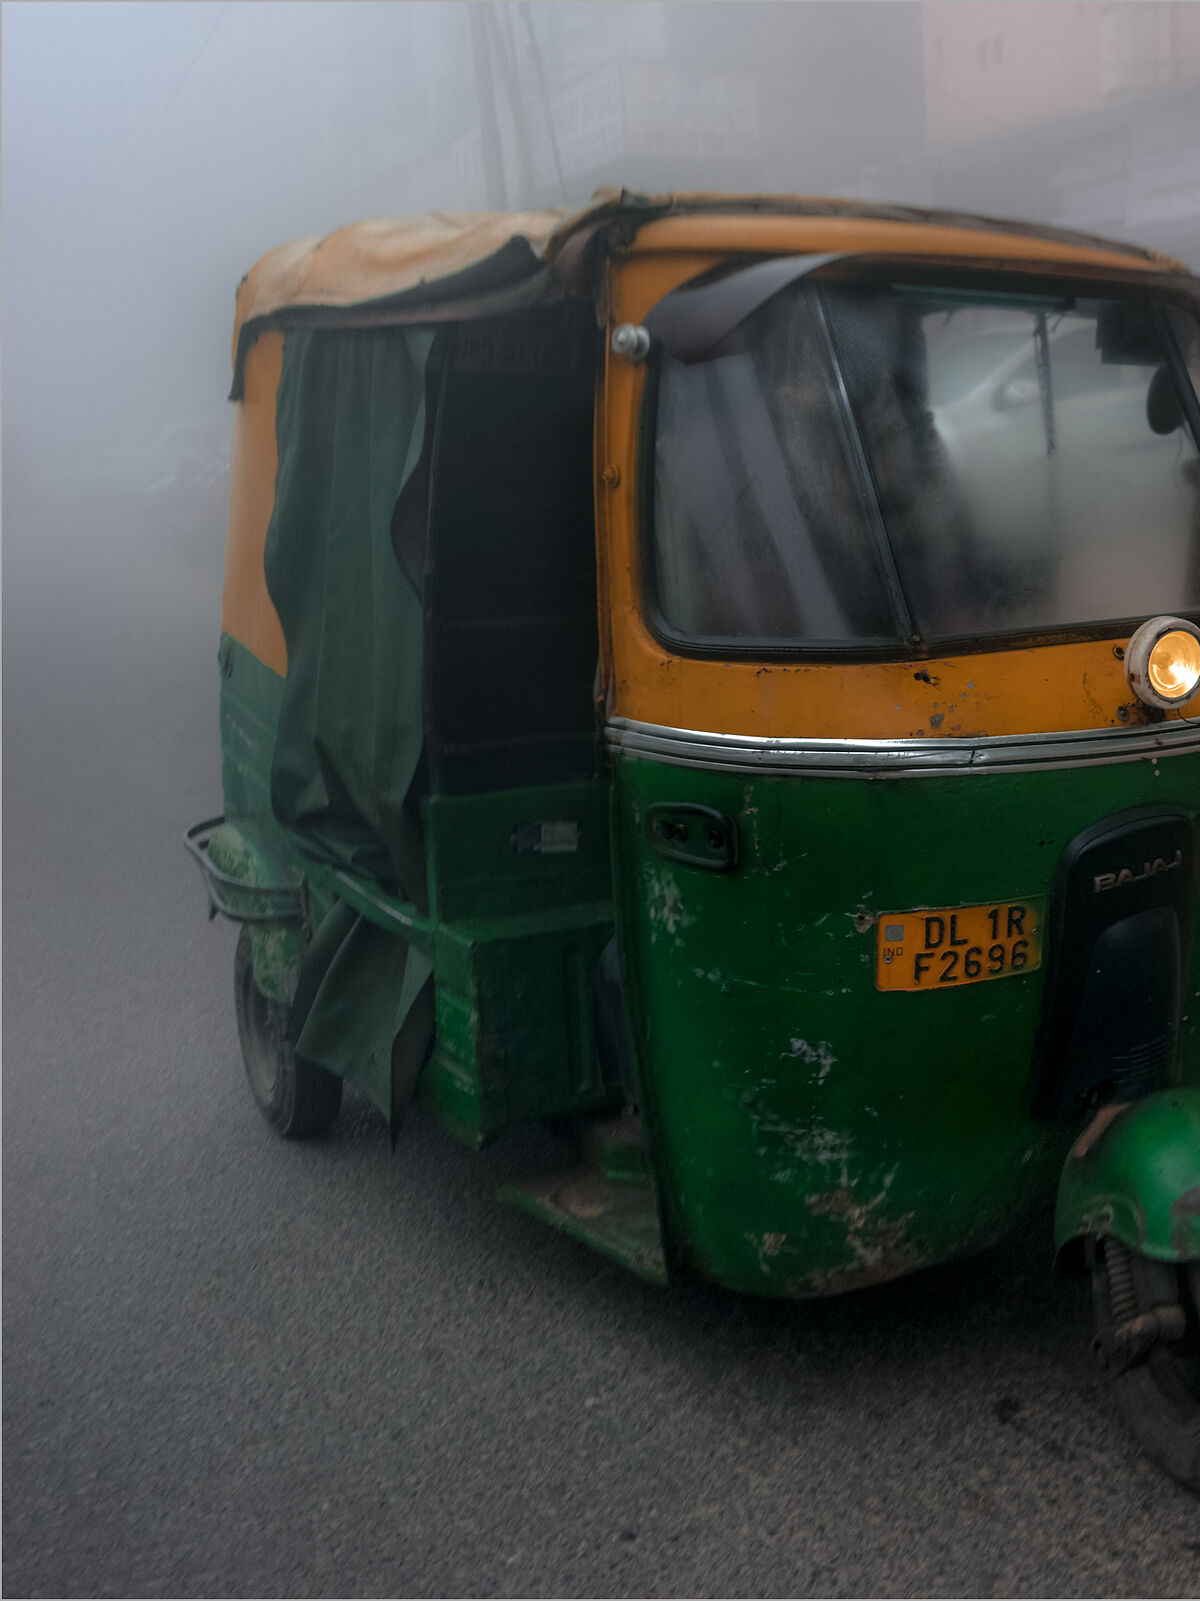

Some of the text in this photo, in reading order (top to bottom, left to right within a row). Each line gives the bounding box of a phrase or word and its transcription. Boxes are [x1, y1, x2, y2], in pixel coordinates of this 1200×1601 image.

[1093, 849, 1182, 893] BAJAJ
[924, 905, 1027, 949] DL 1R
[883, 946, 904, 958] IND
[914, 939, 1029, 985] F2696
